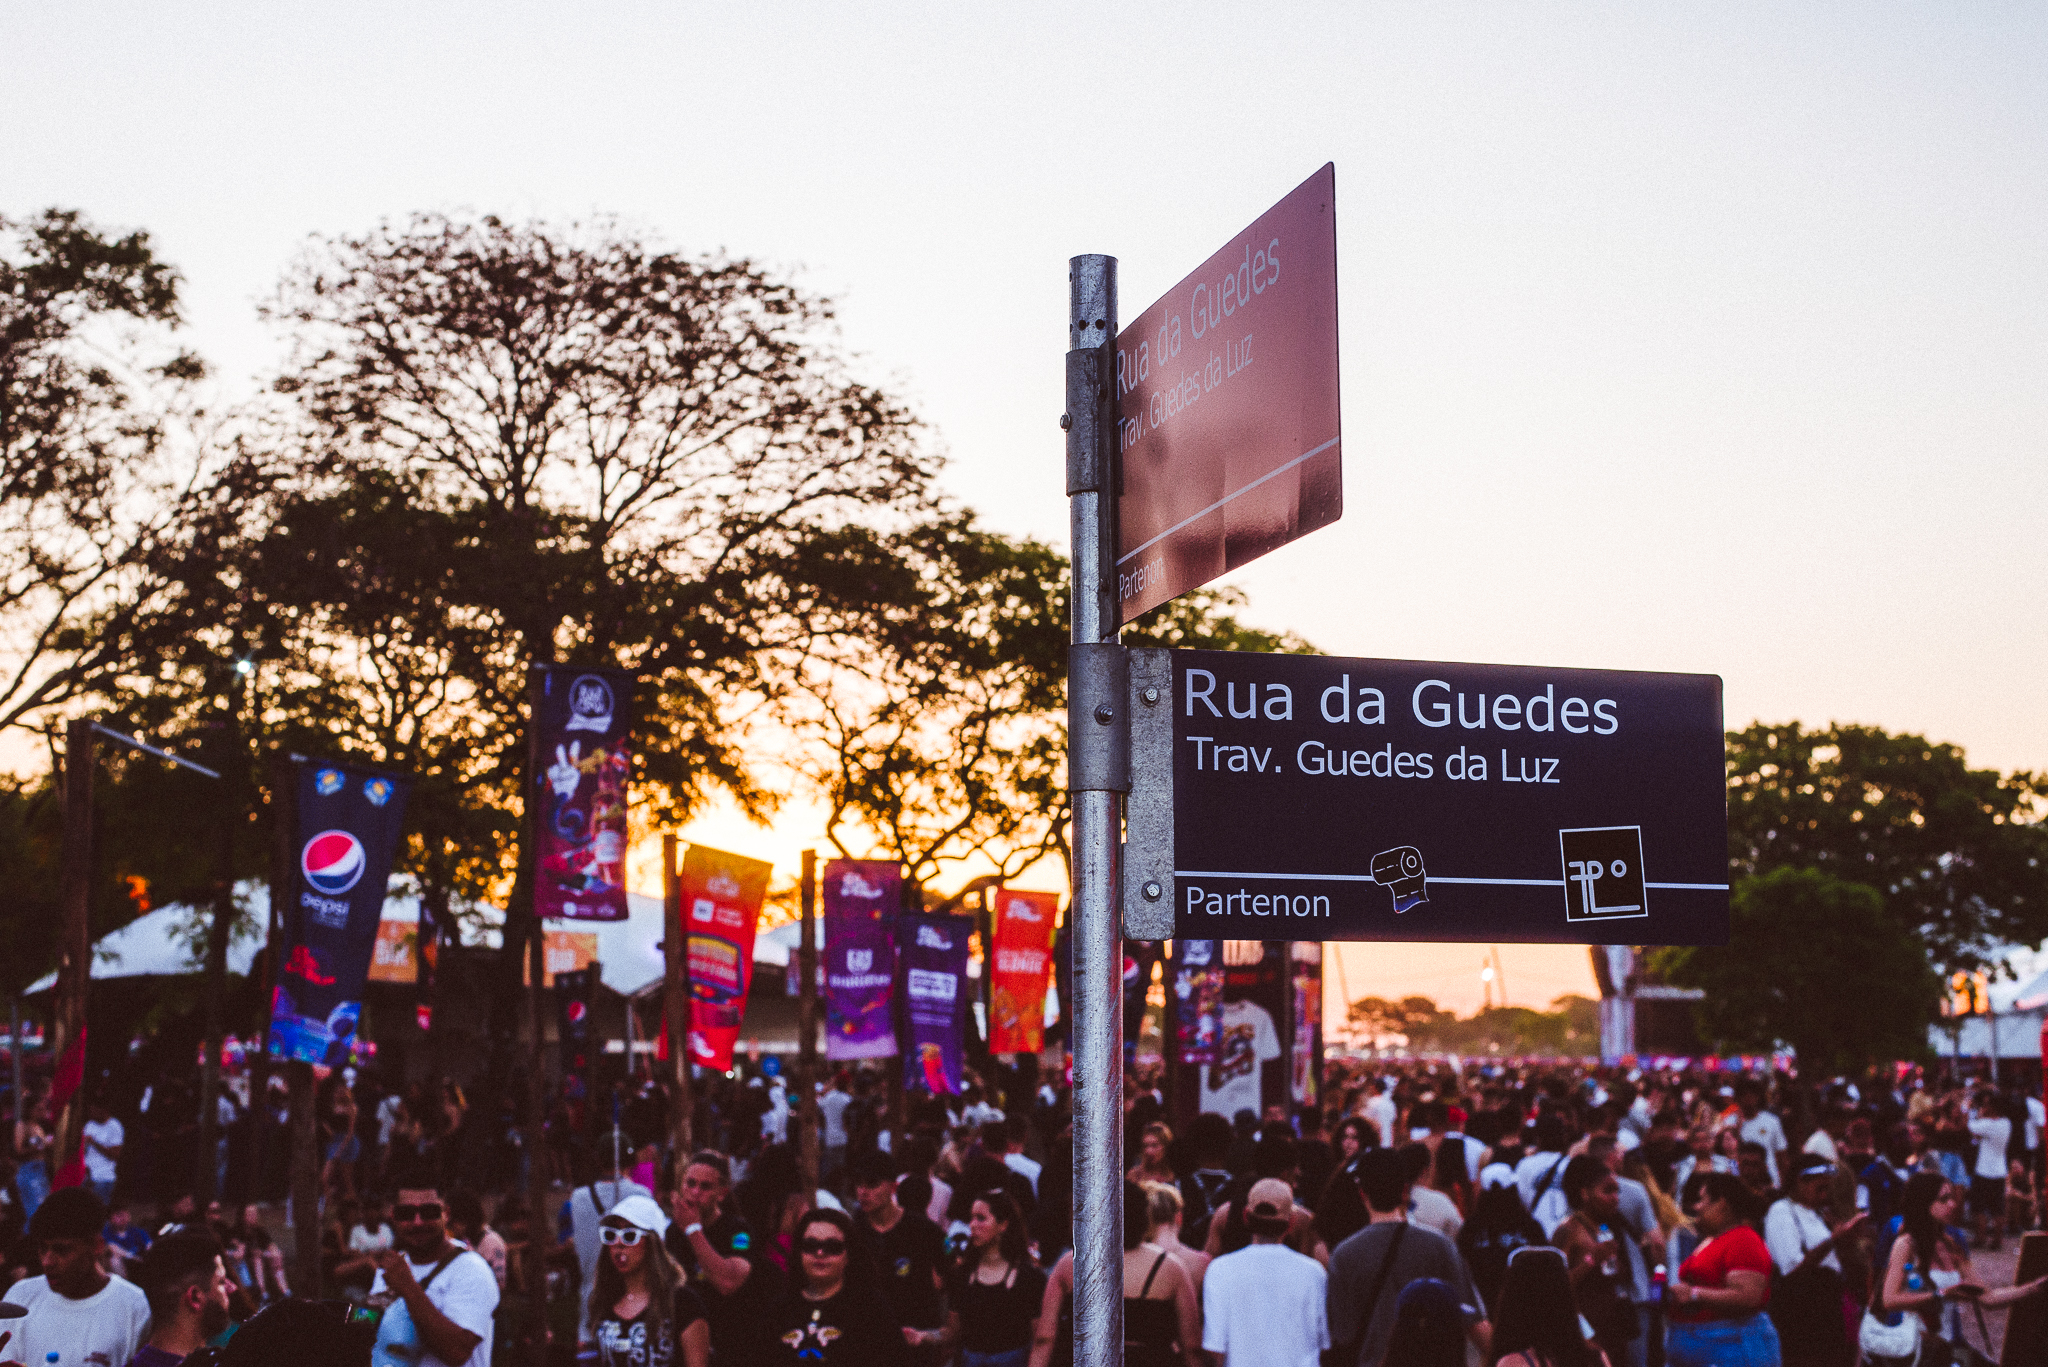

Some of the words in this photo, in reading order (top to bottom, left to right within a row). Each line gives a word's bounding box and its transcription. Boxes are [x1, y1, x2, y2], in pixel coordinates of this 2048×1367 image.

[1117, 341, 1149, 401] Rua
[1157, 309, 1182, 367] da
[1191, 238, 1280, 340] Guedes
[1117, 411, 1146, 454] Trav.
[1150, 371, 1200, 429] Guedes
[1204, 350, 1222, 393] da
[1227, 333, 1253, 378] Luz
[1119, 557, 1164, 603] Partenon
[1185, 668, 1293, 721] Rua
[1320, 673, 1386, 725] da
[1411, 679, 1619, 736] Guedes
[1186, 735, 1282, 774] Trav.
[1296, 740, 1434, 780] Guedes
[1446, 745, 1488, 782] da
[1501, 748, 1561, 784] Luz
[1186, 886, 1331, 918] Partenon
